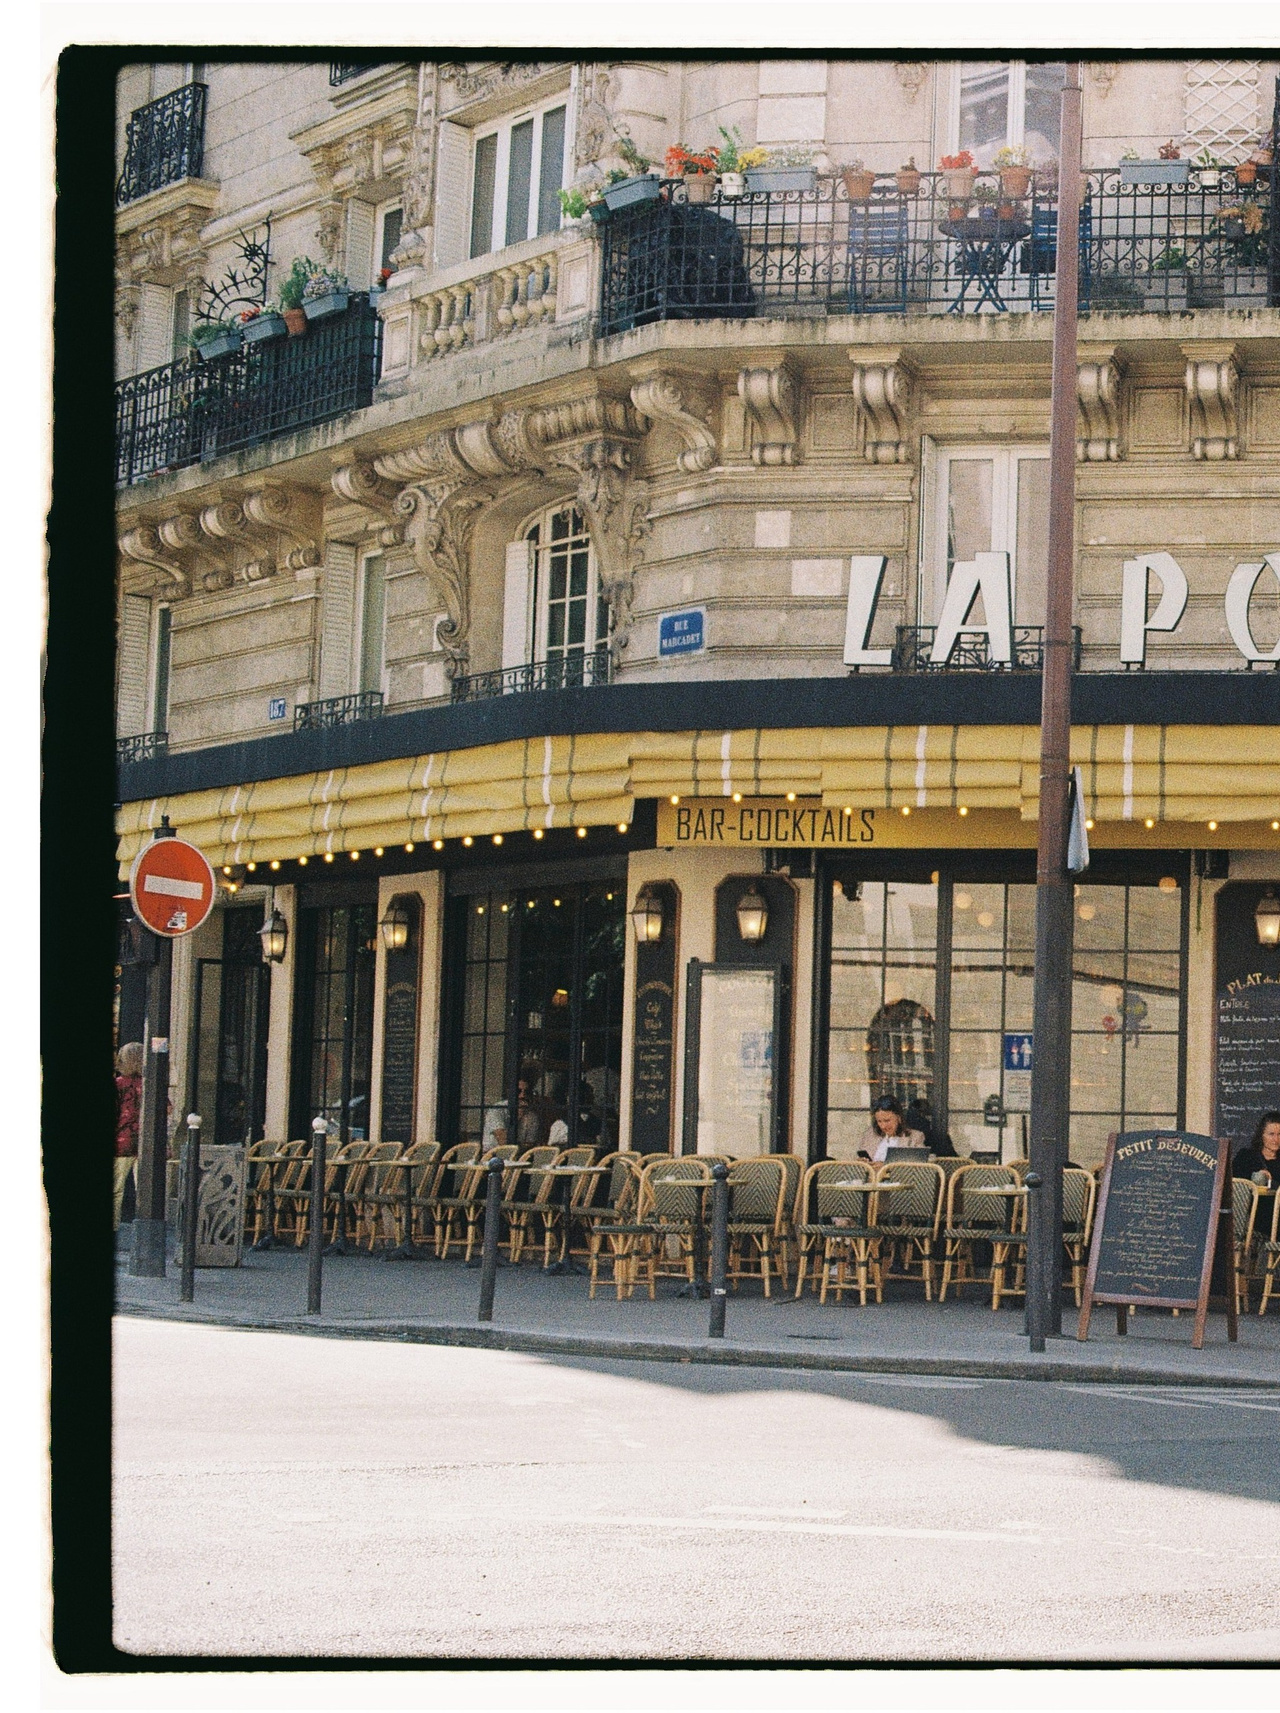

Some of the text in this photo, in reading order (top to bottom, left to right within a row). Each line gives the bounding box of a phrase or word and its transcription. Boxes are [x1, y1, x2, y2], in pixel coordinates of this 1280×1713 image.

[843, 551, 1012, 665] LA
[674, 620, 688, 632] RUE
[676, 807, 875, 842] BAR-COCKTAILS
[1226, 972, 1263, 996] PLAT
[1117, 1139, 1153, 1161] PETIT
